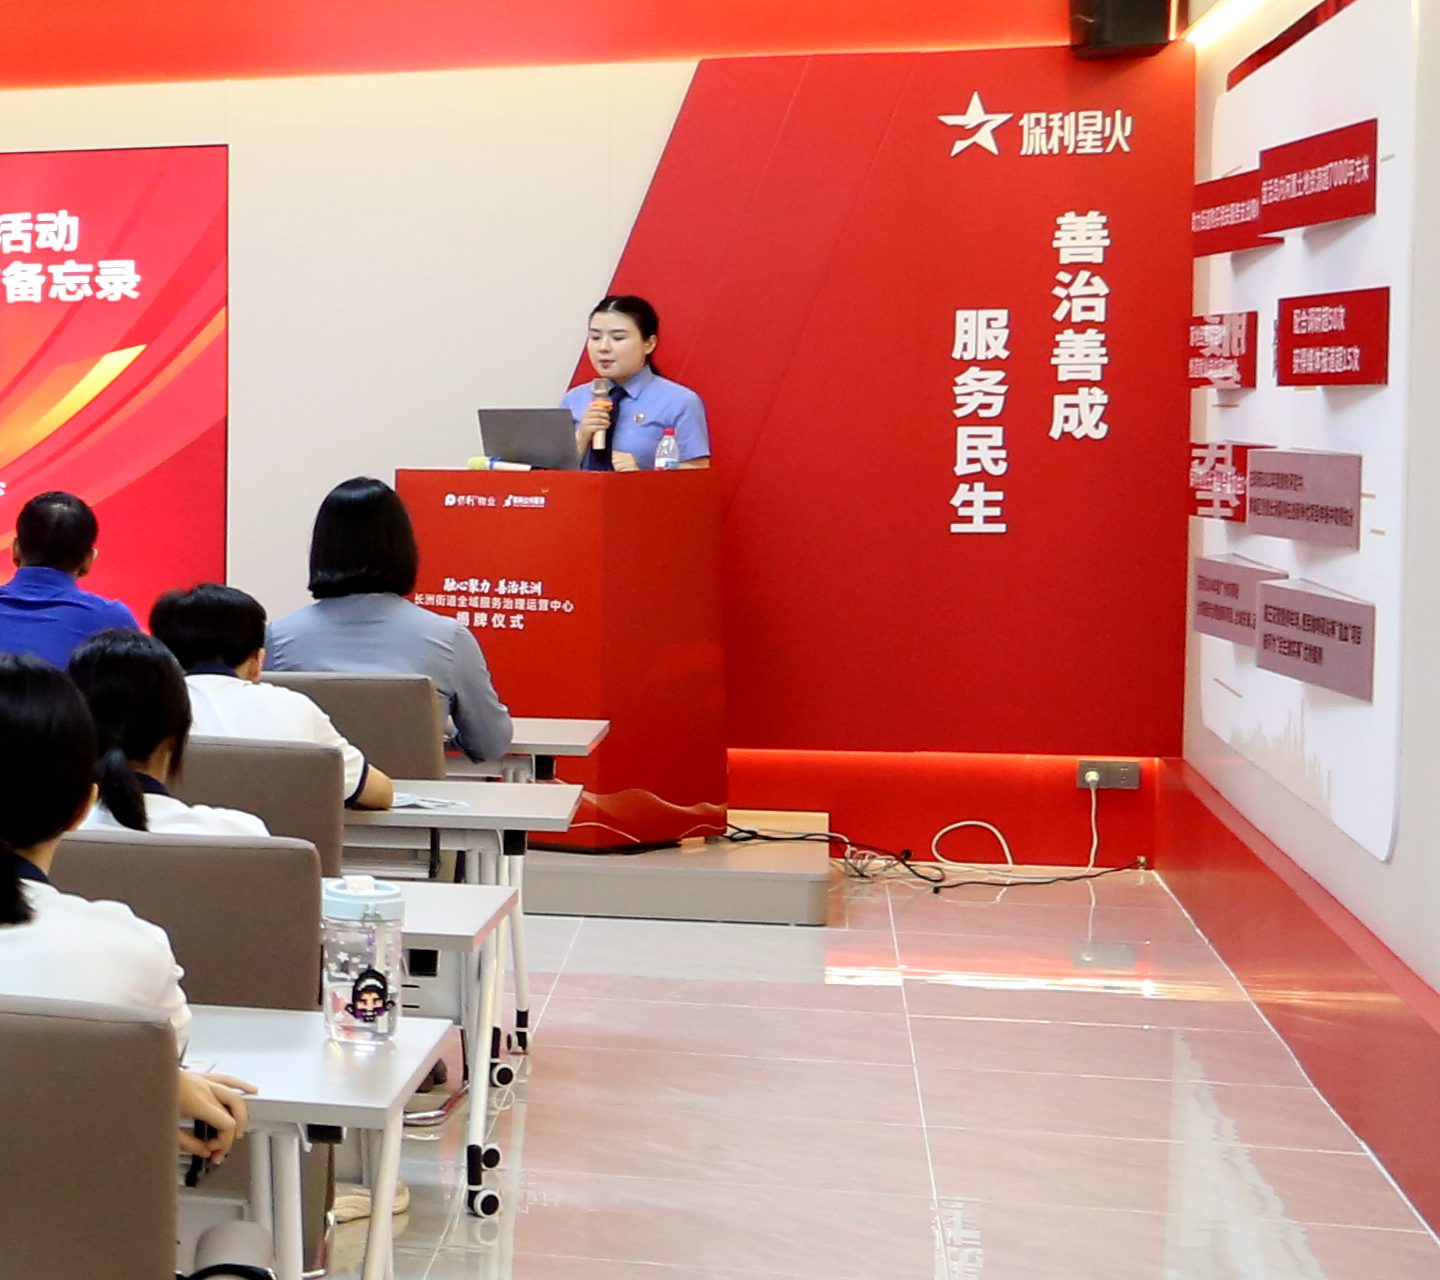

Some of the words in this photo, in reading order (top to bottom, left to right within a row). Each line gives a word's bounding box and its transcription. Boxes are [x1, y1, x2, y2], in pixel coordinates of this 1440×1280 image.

[1019, 109, 1134, 157] 保利星火
[1049, 210, 1112, 442] 善治善成
[949, 308, 1011, 535] 服务民生
[443, 577, 491, 593] 融心聚力
[494, 578, 542, 596] 善治长洲
[456, 610, 525, 630] 揭牌仪式
